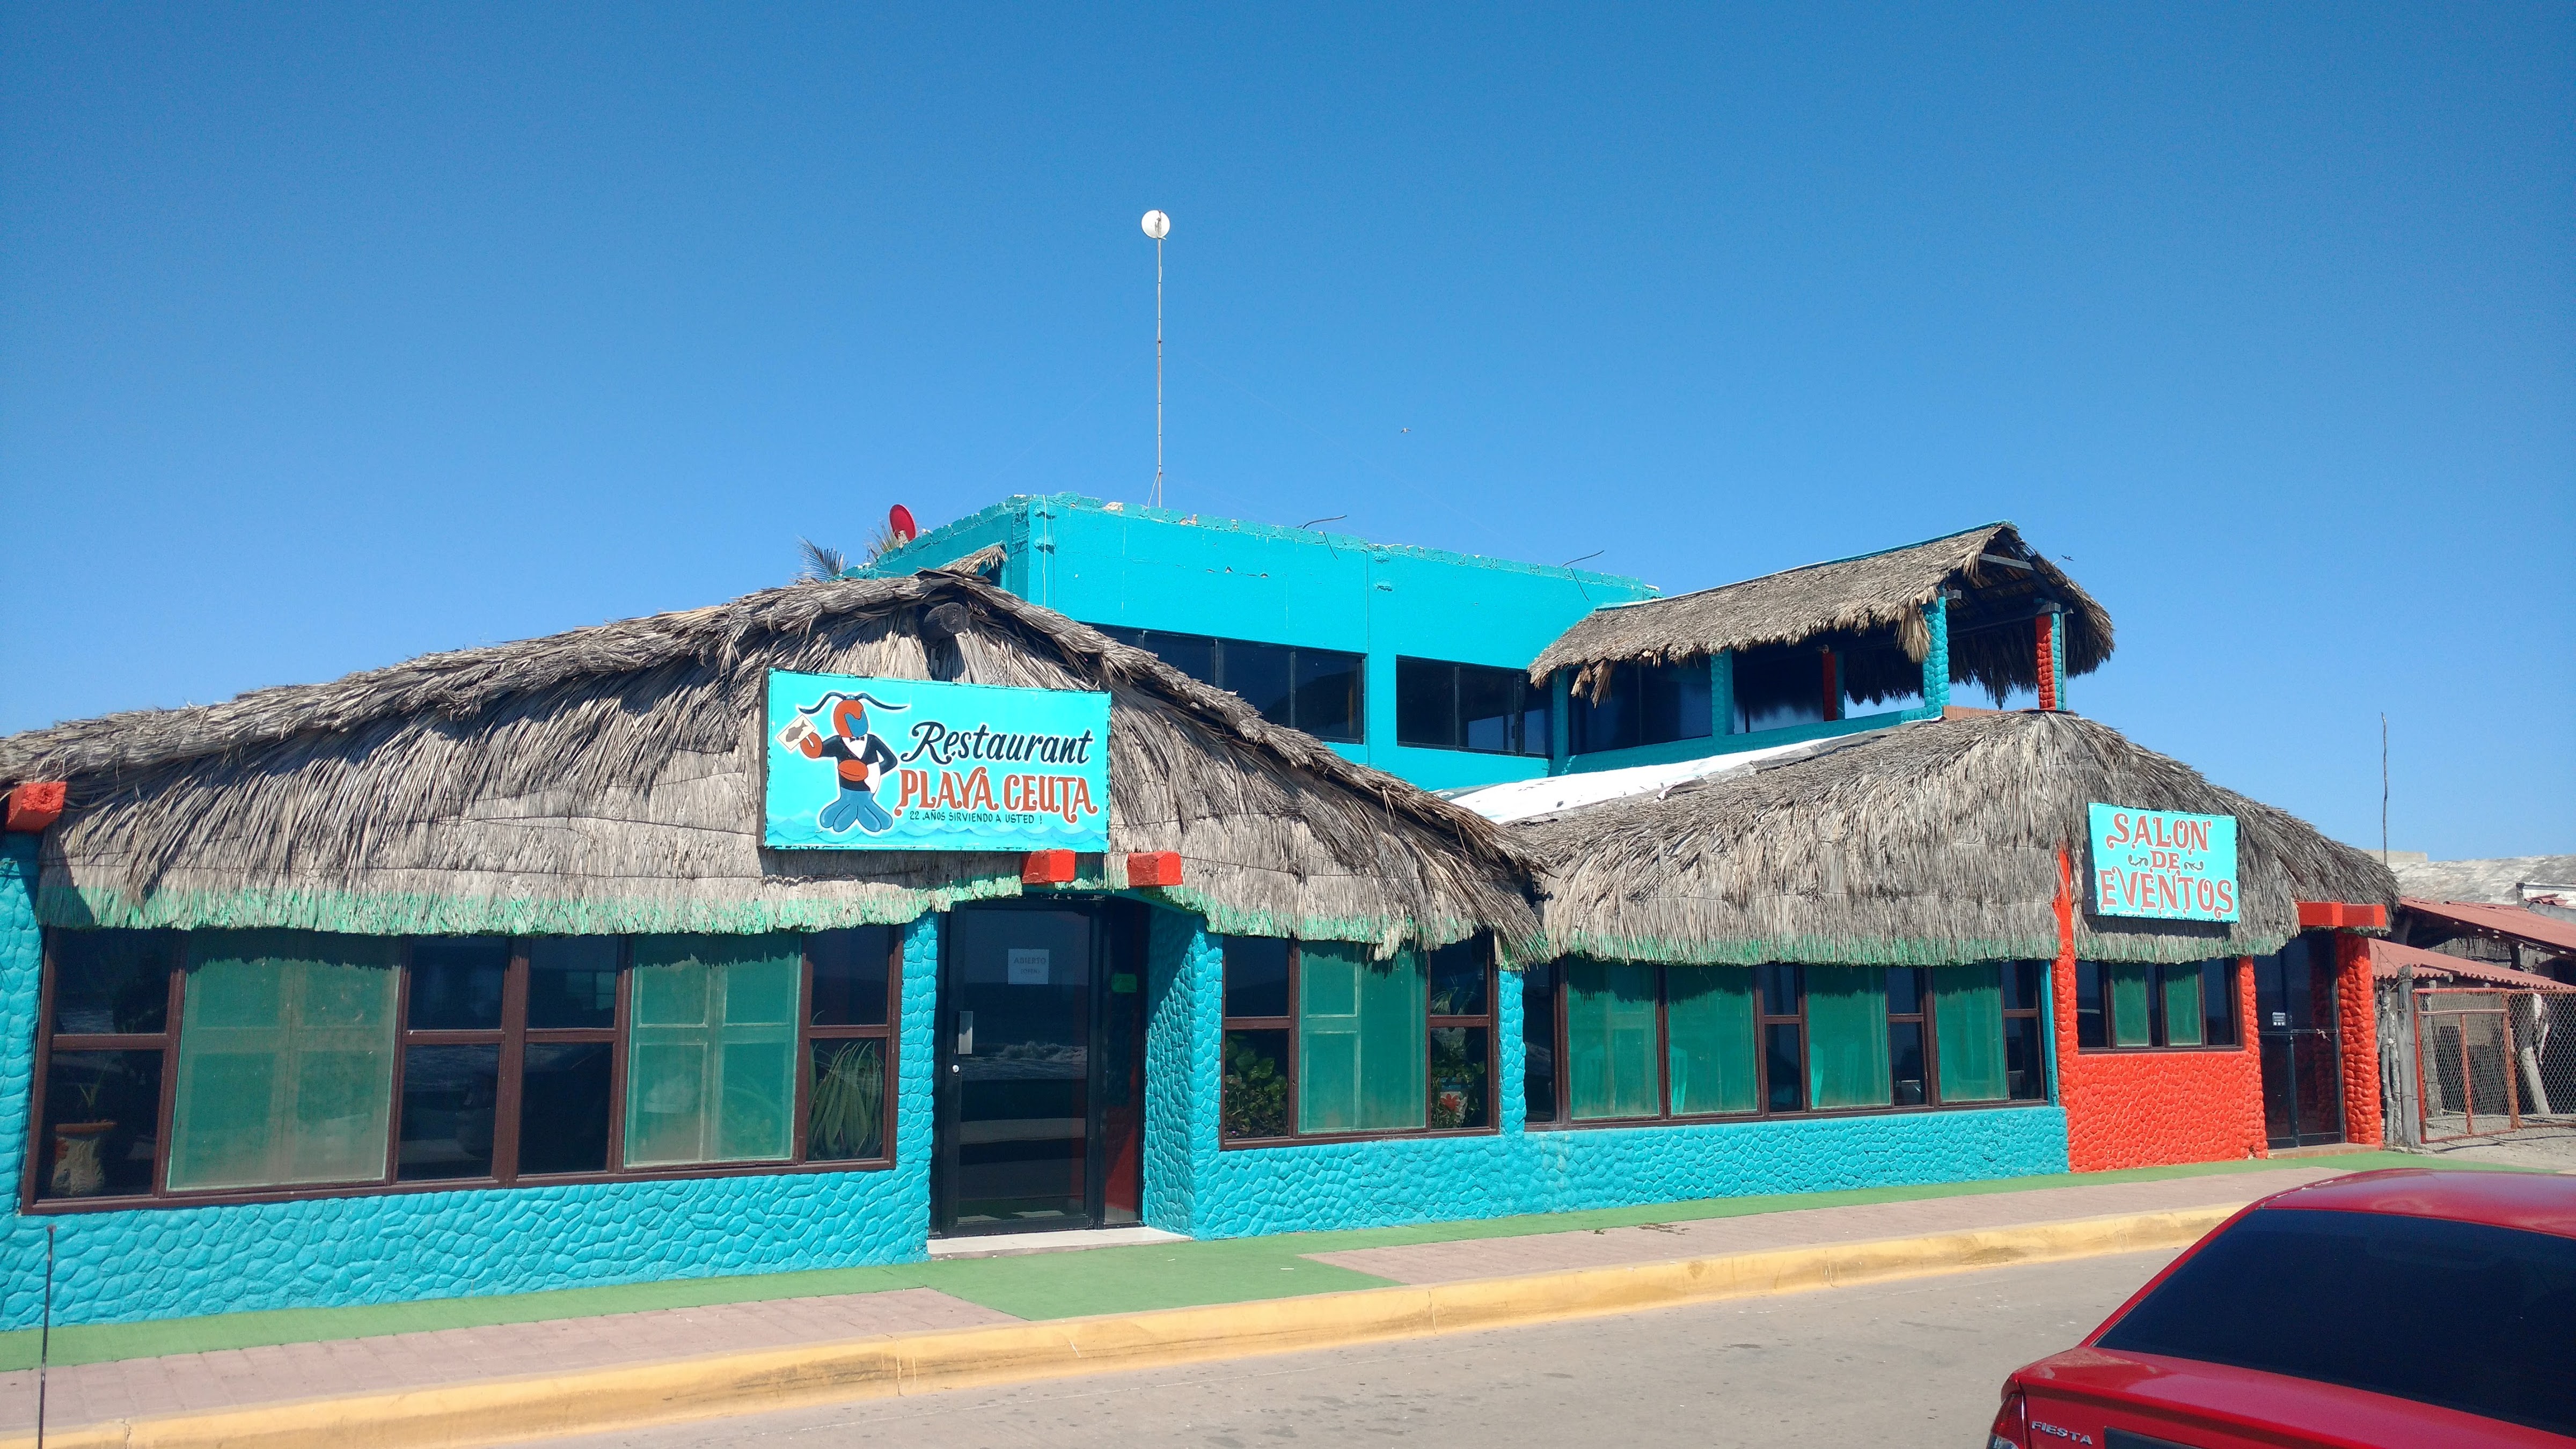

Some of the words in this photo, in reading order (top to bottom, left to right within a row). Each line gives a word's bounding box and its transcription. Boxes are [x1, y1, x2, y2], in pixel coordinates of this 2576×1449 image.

[900, 721, 1094, 765] Restaurant
[894, 767, 1000, 817] PLAYA
[1003, 774, 1098, 823] CEUTA
[910, 810, 919, 820] 22
[922, 809, 946, 821] AÑOS
[949, 811, 993, 822] SIRVIENDO
[996, 814, 1001, 823] A
[1005, 814, 1035, 824] USTED
[2105, 813, 2212, 855] SALON
[2149, 850, 2180, 874] DE
[2098, 866, 2234, 919] EVENTOS
[2031, 1421, 2093, 1445] FIESTA
